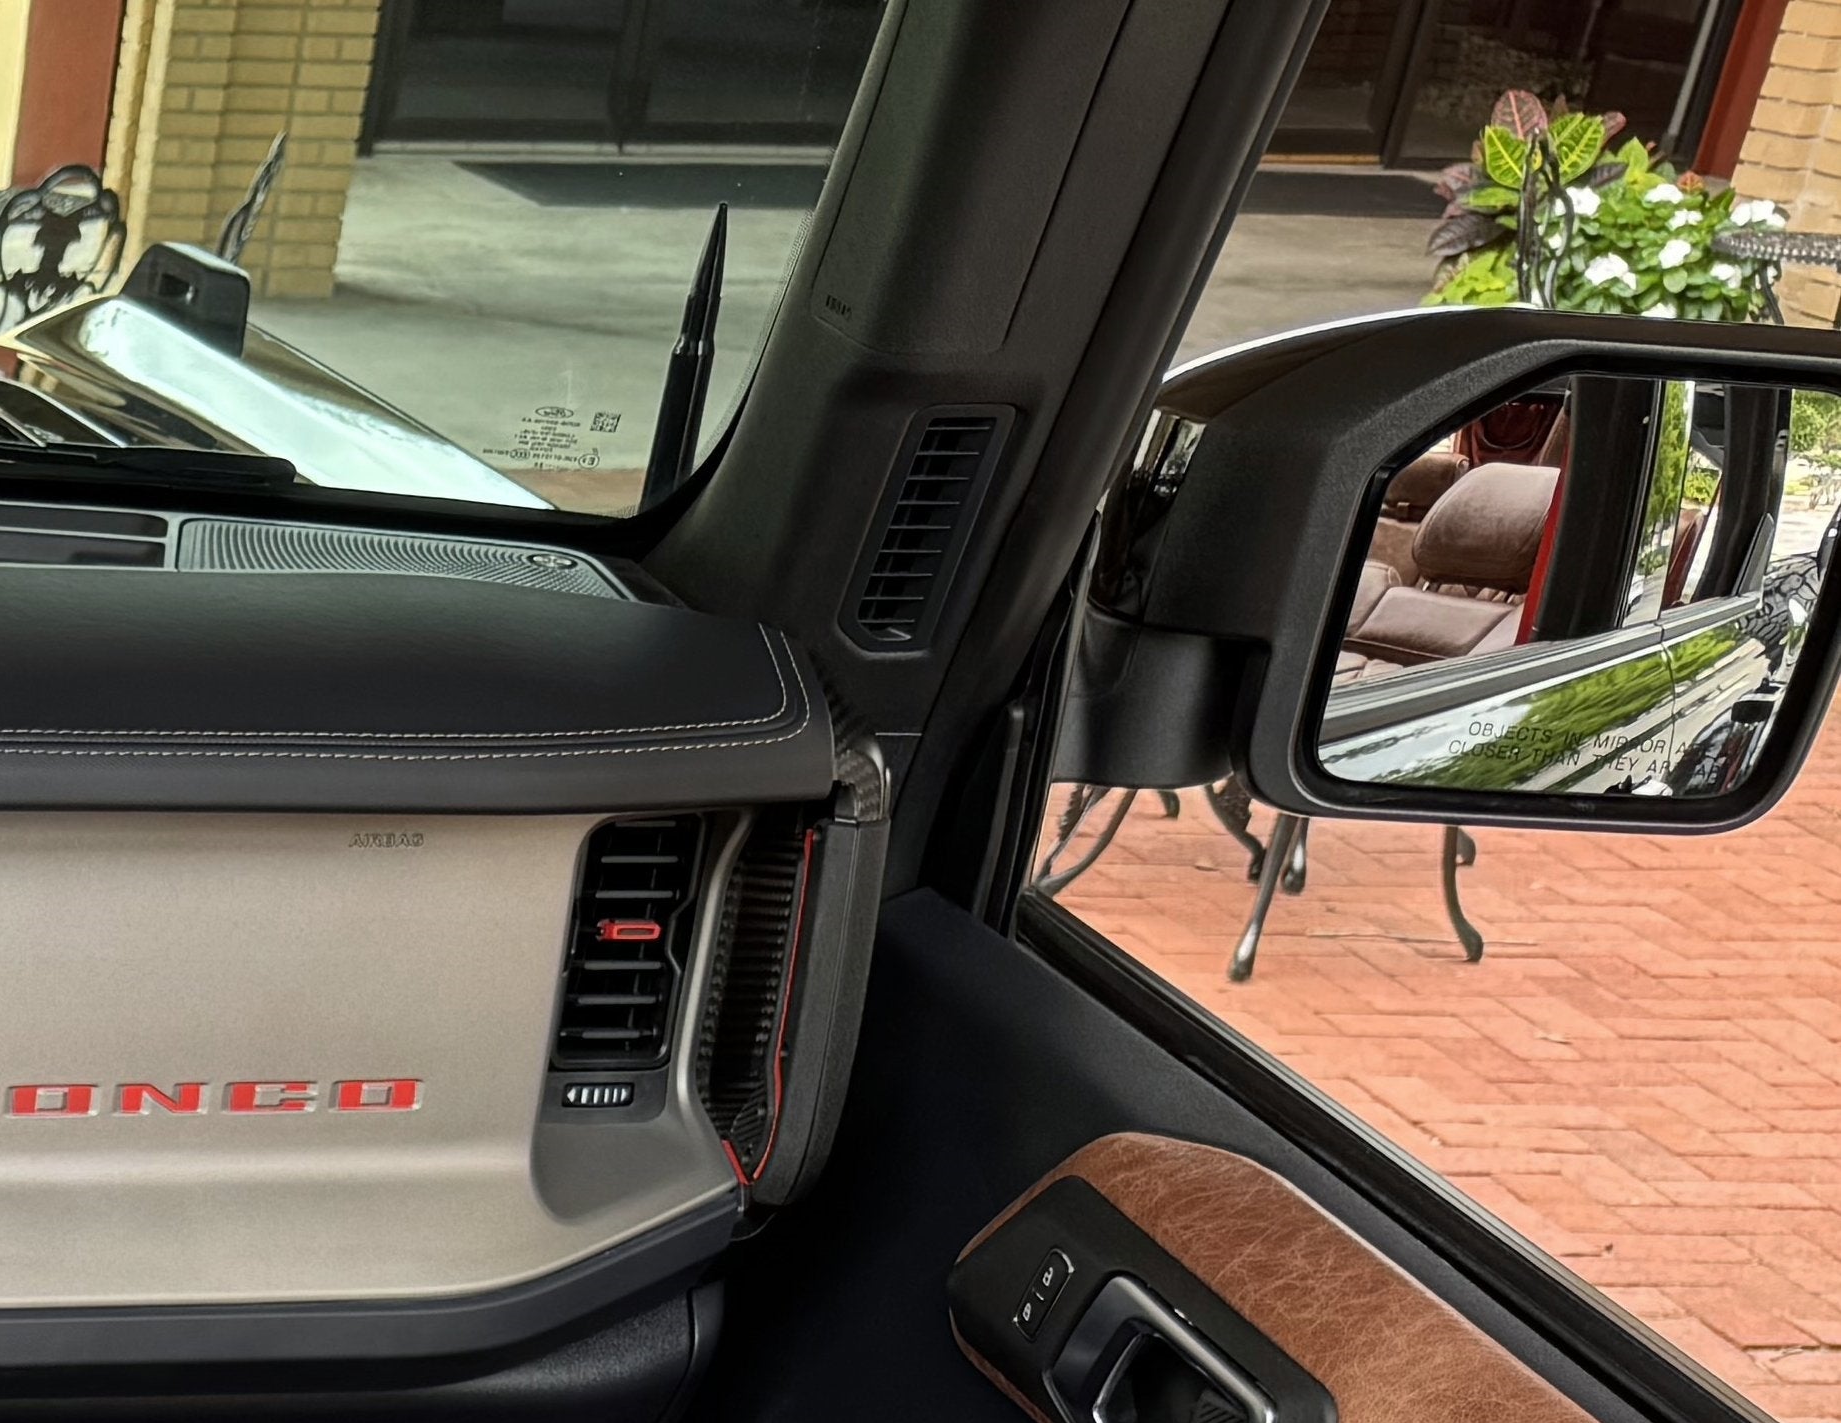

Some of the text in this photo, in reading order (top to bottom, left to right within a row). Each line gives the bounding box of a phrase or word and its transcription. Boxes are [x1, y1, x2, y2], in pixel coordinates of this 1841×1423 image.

[1468, 721, 1553, 743] OBJECTS
[1564, 733, 1581, 746] IN
[1448, 740, 1520, 759] CLOSER
[1532, 747, 1580, 767] THAN
[348, 833, 424, 848] AIRBAG
